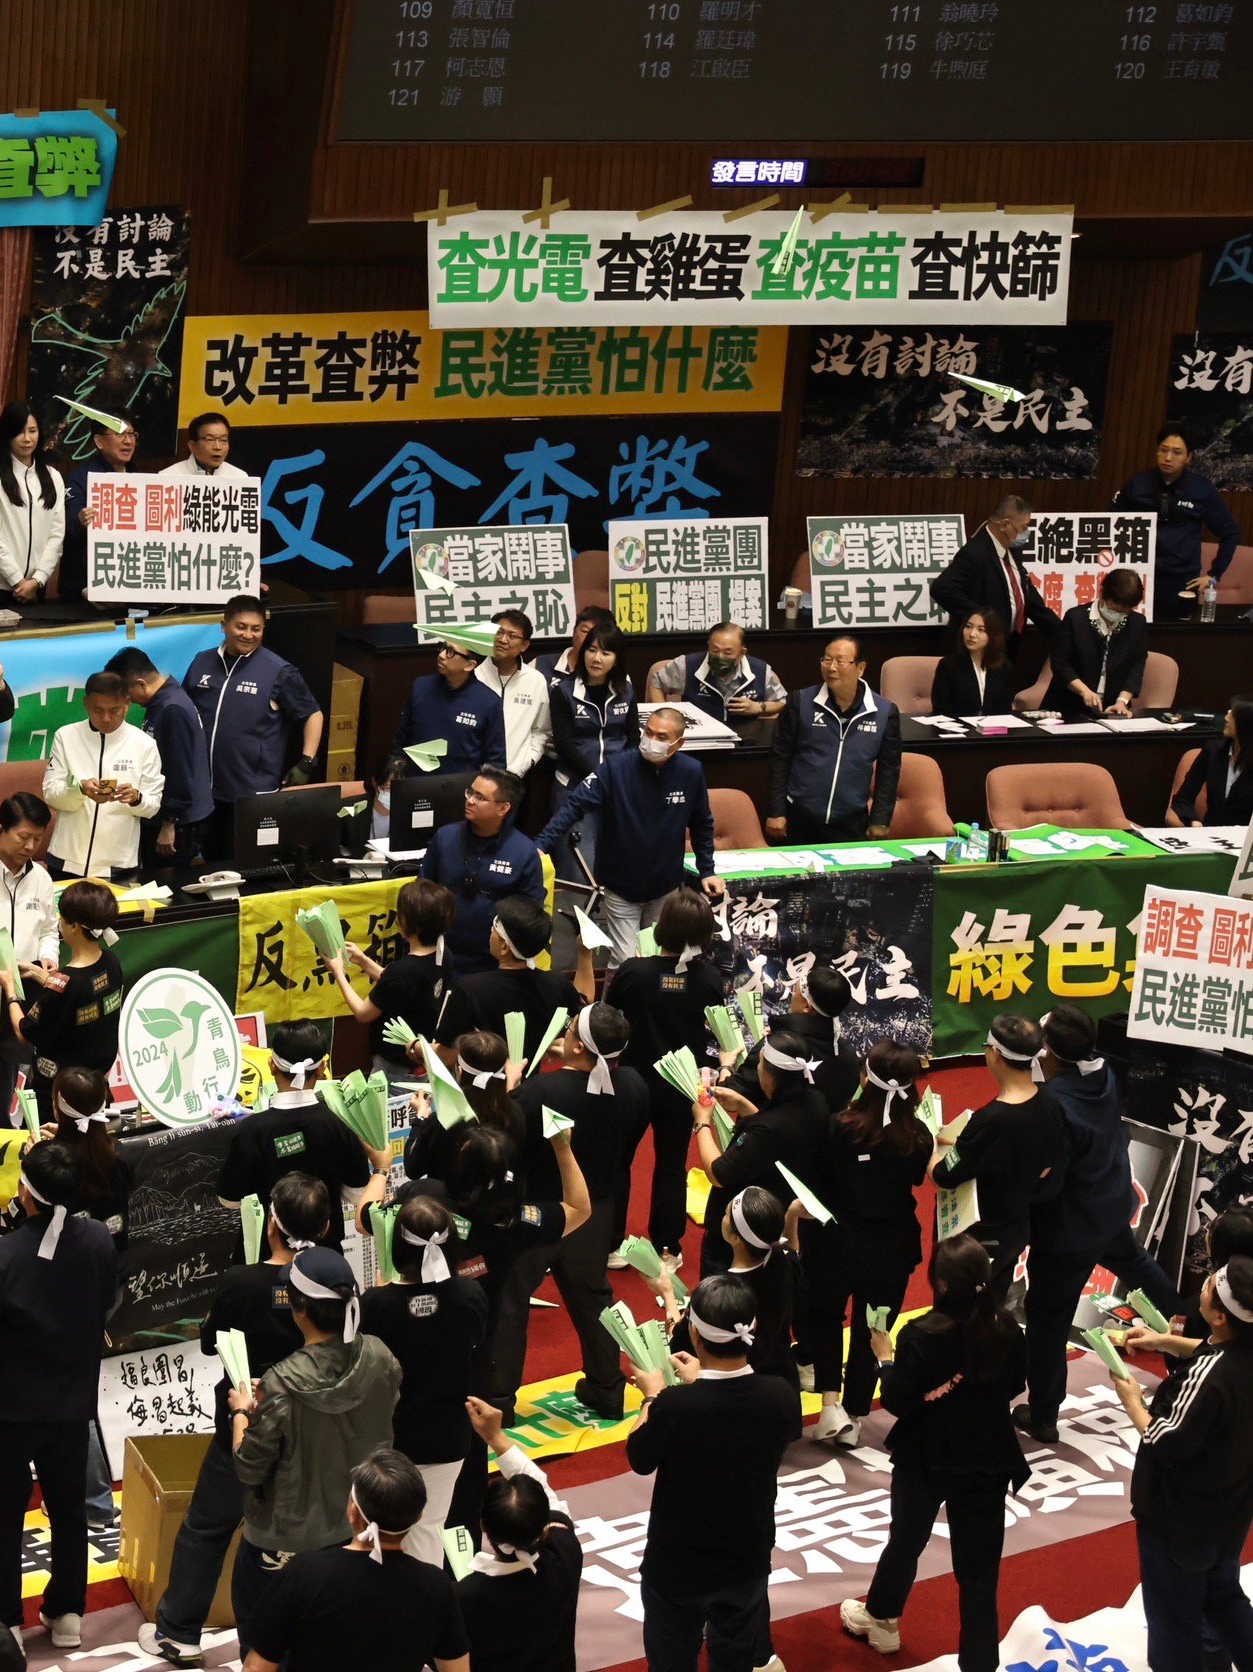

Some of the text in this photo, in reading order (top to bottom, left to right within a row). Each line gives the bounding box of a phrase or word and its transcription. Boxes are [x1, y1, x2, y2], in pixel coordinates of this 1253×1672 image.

[399, 2, 432, 19] 109
[647, 4, 679, 20] 110
[890, 7, 921, 22] 111
[1125, 7, 1156, 23] 112
[395, 28, 510, 49] 113 張智倫
[643, 33, 675, 49] 114
[885, 35, 916, 51] 115
[1119, 35, 1151, 51] 116
[392, 58, 506, 78] 117 柯志恩
[639, 62, 671, 78] 118
[880, 63, 911, 79] 119
[1114, 62, 1145, 79] 120
[387, 90, 419, 106] 121
[712, 160, 805, 184] 發言時間
[52, 248, 173, 280] 不是民主
[436, 230, 1062, 303] 查光電 查雞蛋 查疫苗 查快篩
[203, 325, 758, 406] 改革查弊 民進黨怕什麼
[810, 332, 980, 380] 沒有討論
[1174, 345, 1253, 394] 沒有
[931, 386, 1094, 434] 不是民主
[91, 482, 259, 534] 調查 圖利綠能光電
[443, 529, 566, 584] 當家鬧事
[643, 523, 763, 575] 民進黨團
[839, 519, 961, 571] 當家鬧事
[91, 541, 255, 591] 民進黨怕什麼?
[615, 581, 649, 633] 反對
[655, 578, 722, 631] 民進黨團
[1143, 897, 1205, 960] 調查
[946, 903, 1143, 1004] 綠色
[133, 1040, 169, 1067] 2024
